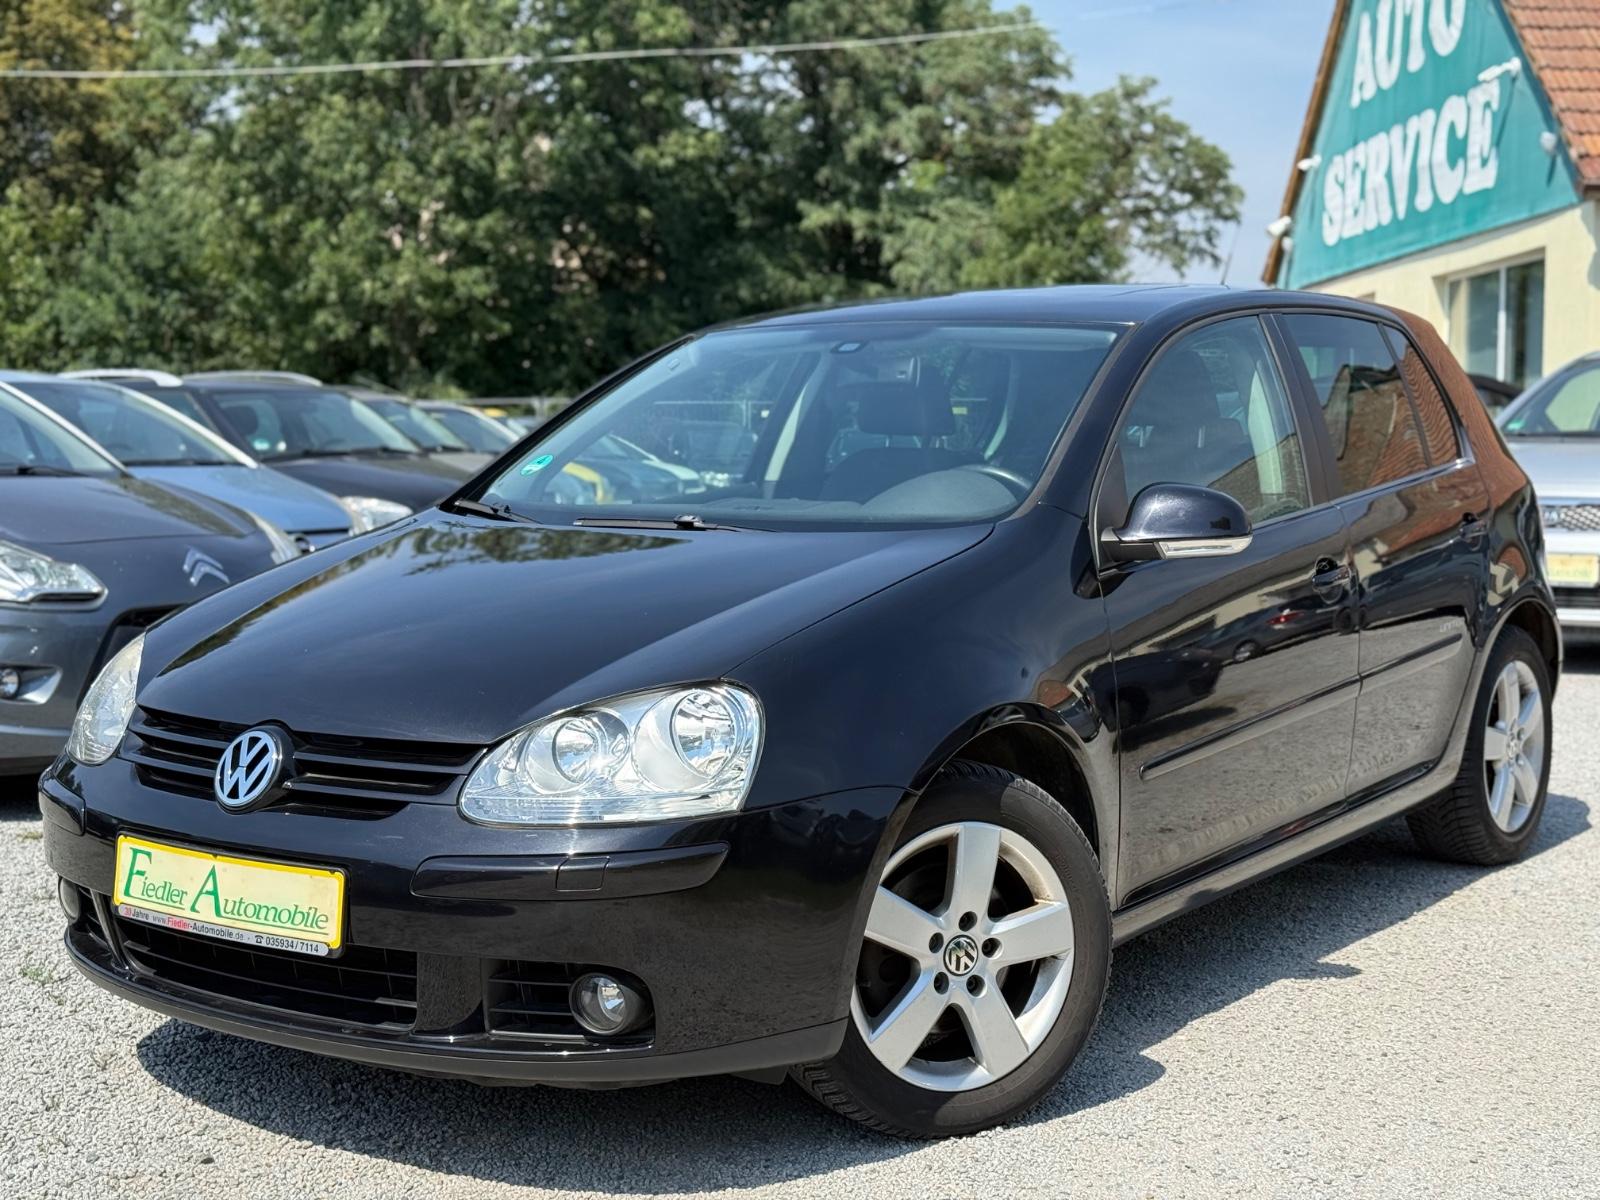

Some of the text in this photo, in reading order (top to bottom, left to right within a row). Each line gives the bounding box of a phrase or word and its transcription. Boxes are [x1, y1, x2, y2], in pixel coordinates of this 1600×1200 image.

[1350, 0, 1466, 109] AUTO
[1322, 80, 1500, 247] SERVICE
[217, 733, 276, 803] VW
[123, 847, 329, 930] Fiedler Automobile
[132, 908, 150, 921] Jahre
